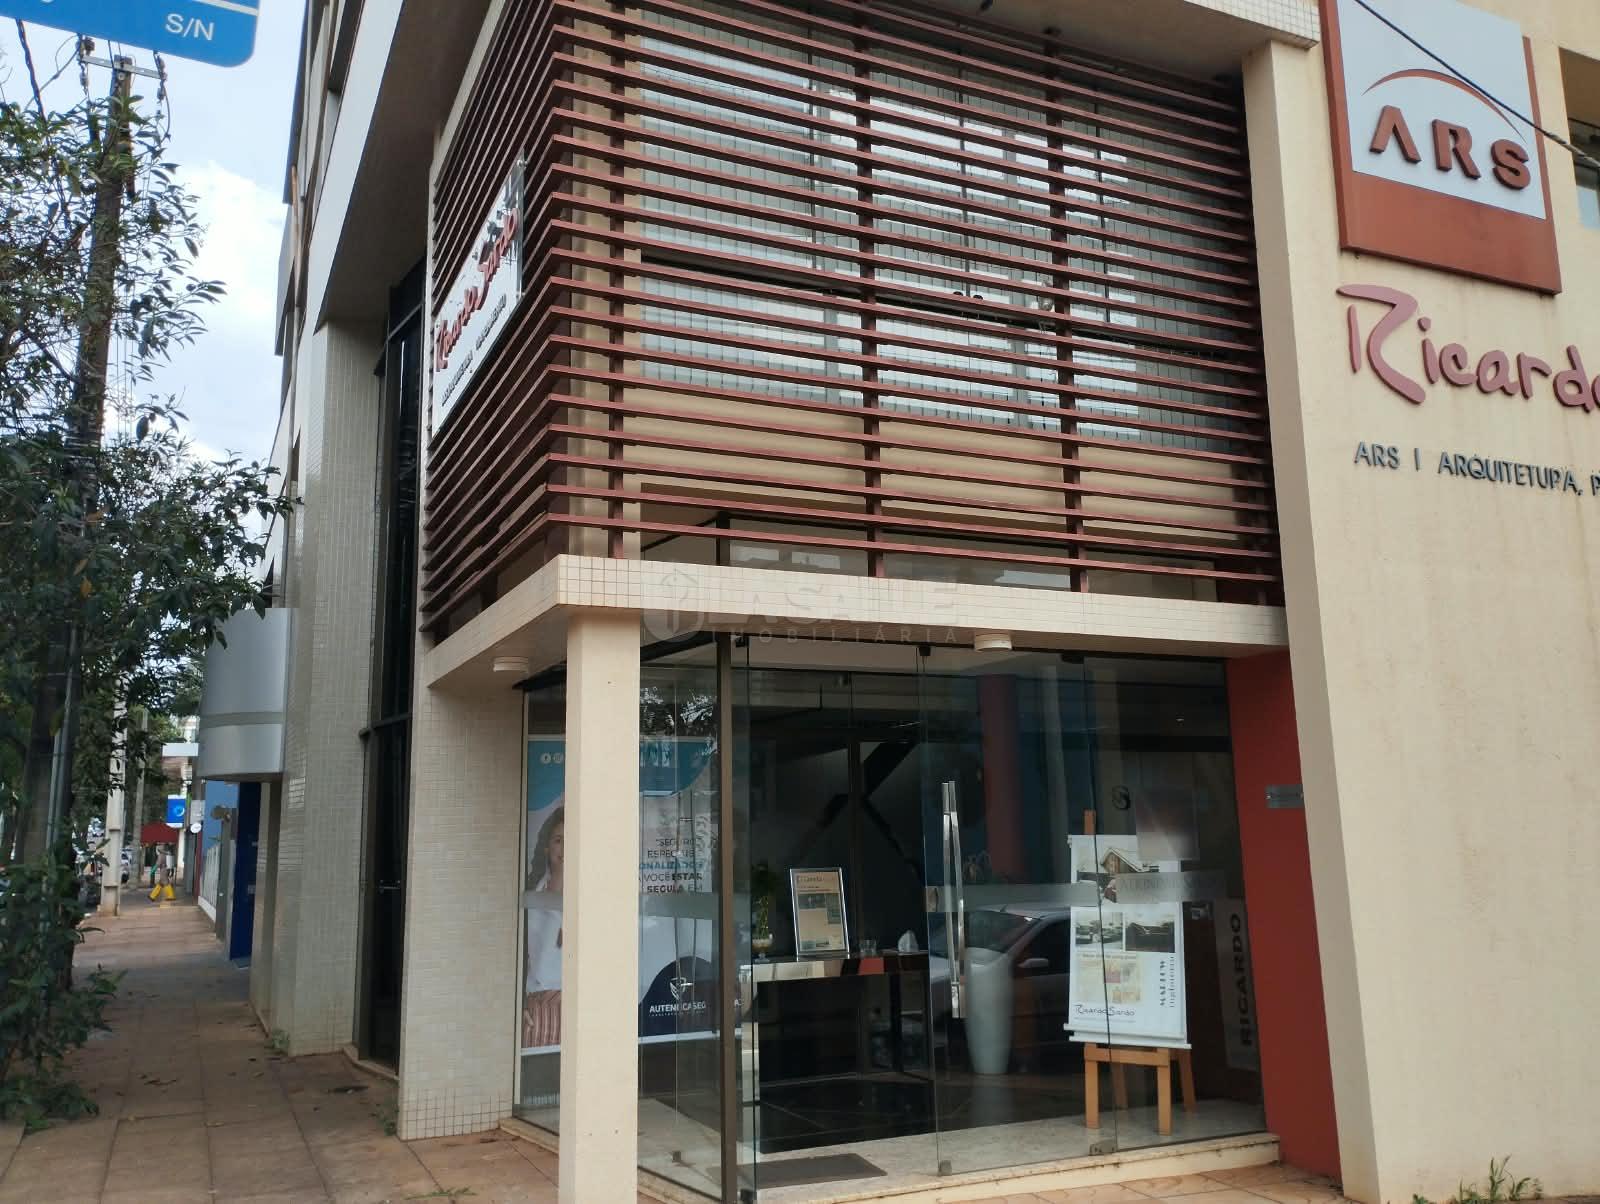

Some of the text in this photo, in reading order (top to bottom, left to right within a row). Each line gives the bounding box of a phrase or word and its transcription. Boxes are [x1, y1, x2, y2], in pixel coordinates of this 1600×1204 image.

[165, 13, 215, 41] S/N
[1369, 104, 1532, 190] ARS
[1336, 284, 1600, 414] Ricard
[1354, 441, 1399, 469] ARS
